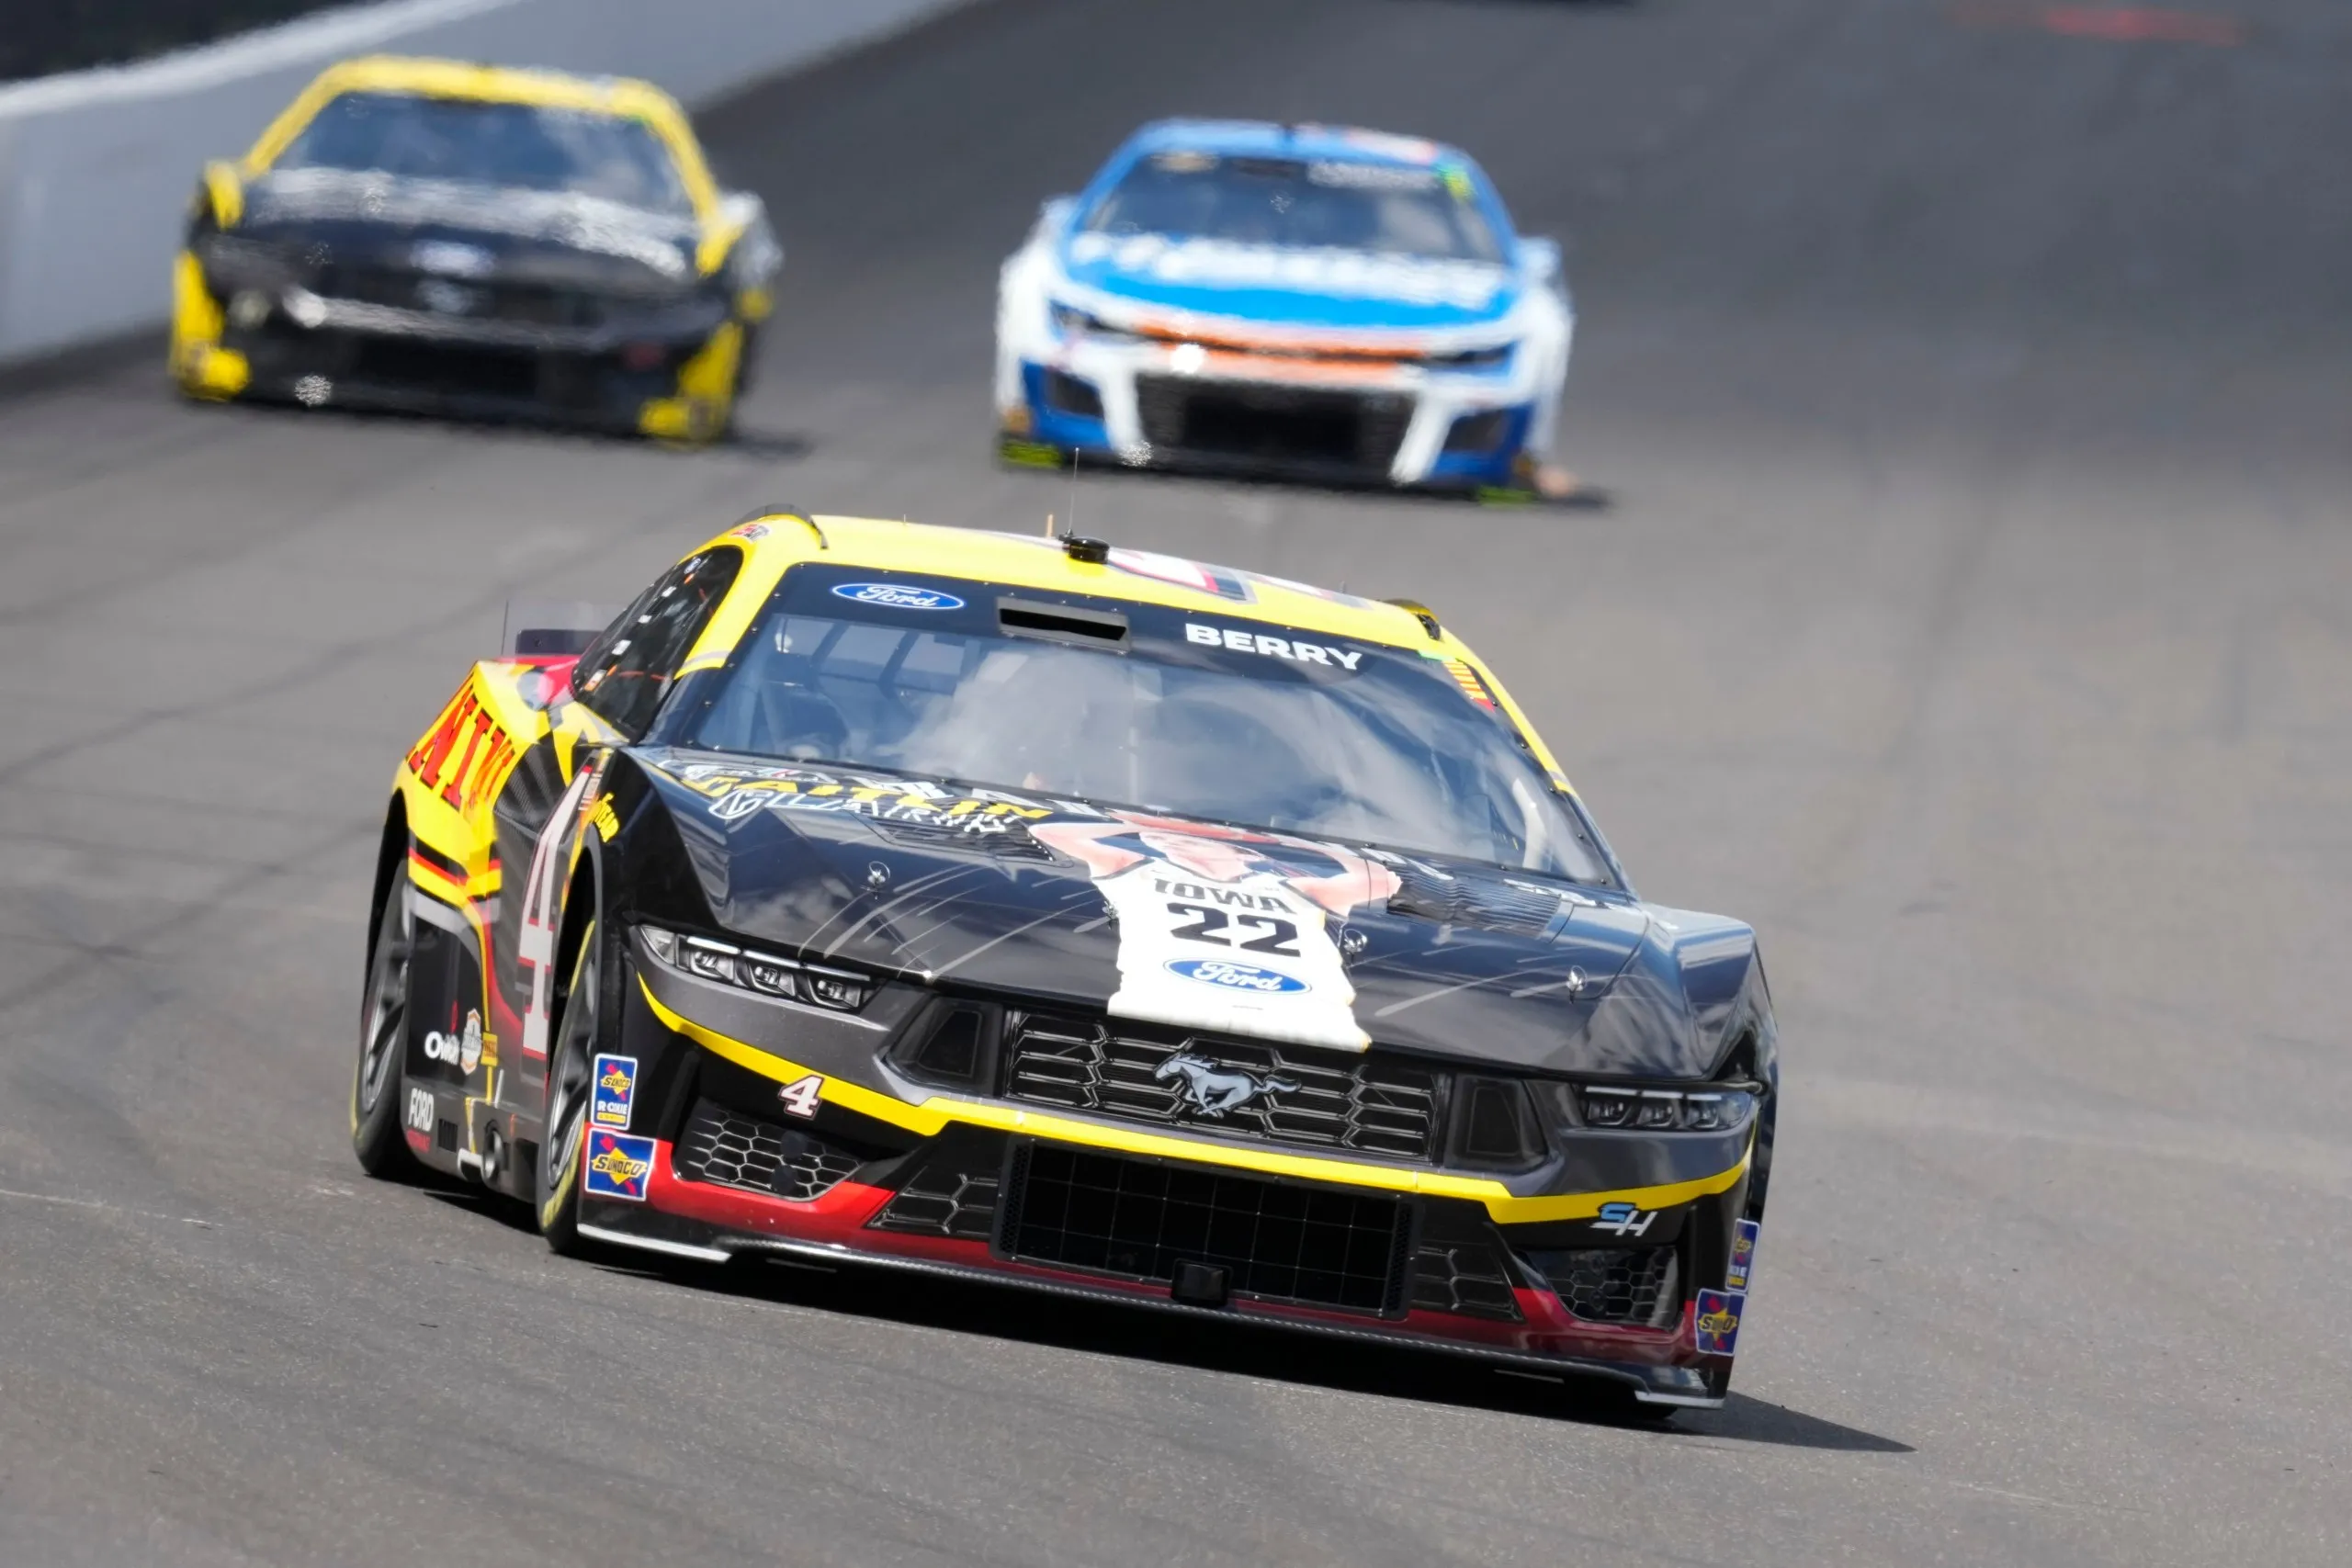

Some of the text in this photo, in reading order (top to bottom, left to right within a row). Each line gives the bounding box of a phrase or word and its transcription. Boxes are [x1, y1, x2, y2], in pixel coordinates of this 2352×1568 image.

[854, 584, 942, 609] Ford
[1184, 623, 1363, 671] BERRY
[1154, 878, 1298, 915] IOWA
[1166, 902, 1302, 957] 22
[1191, 960, 1284, 992] Ford
[408, 1088, 435, 1132] FORD
[778, 1074, 823, 1120] 4
[596, 1156, 643, 1177] SUNOCO
